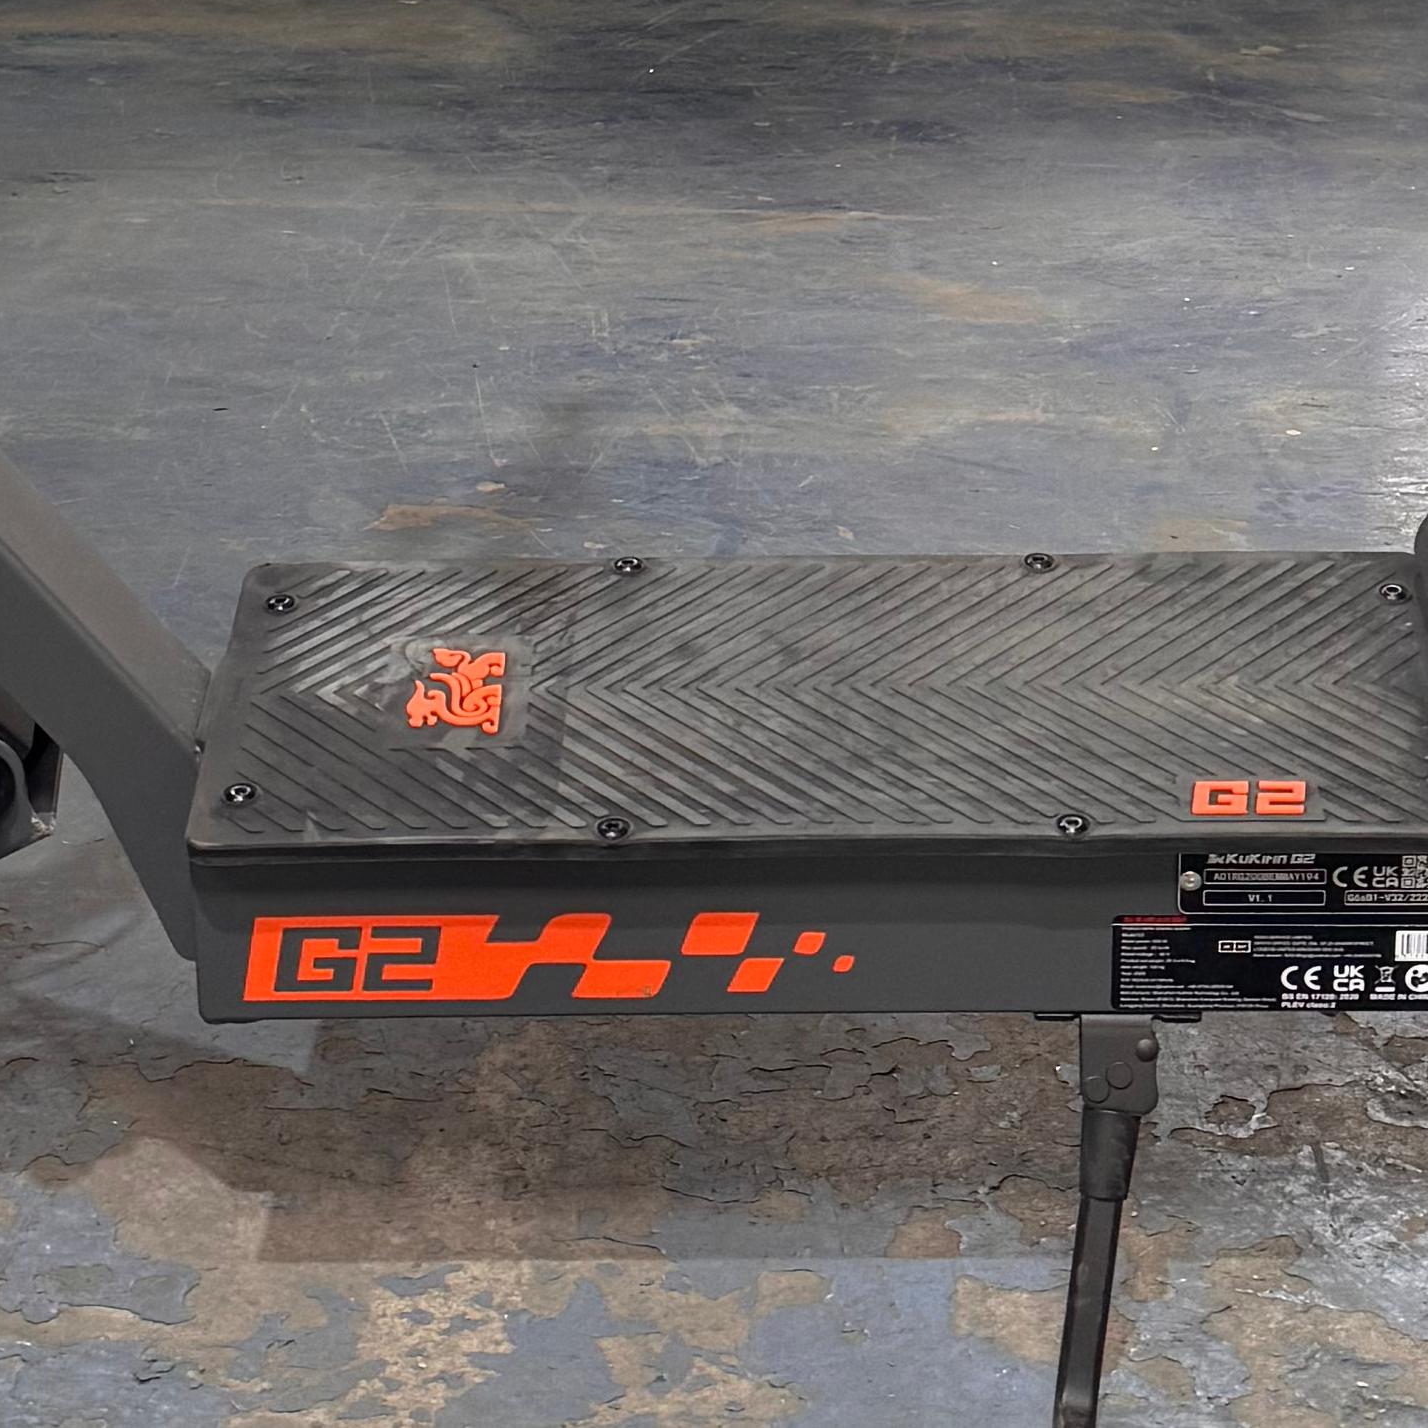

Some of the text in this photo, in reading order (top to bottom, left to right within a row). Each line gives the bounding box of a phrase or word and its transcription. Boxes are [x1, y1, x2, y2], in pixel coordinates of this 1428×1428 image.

[1190, 780, 1307, 816] G2
[1290, 853, 1317, 865] G2
[1332, 866, 1369, 888] CE
[1372, 866, 1400, 877] UK
[1371, 877, 1399, 888] CA
[274, 926, 441, 992] G2
[1280, 965, 1323, 991] CE
[1333, 965, 1365, 978] UK
[1332, 978, 1366, 992] CA
